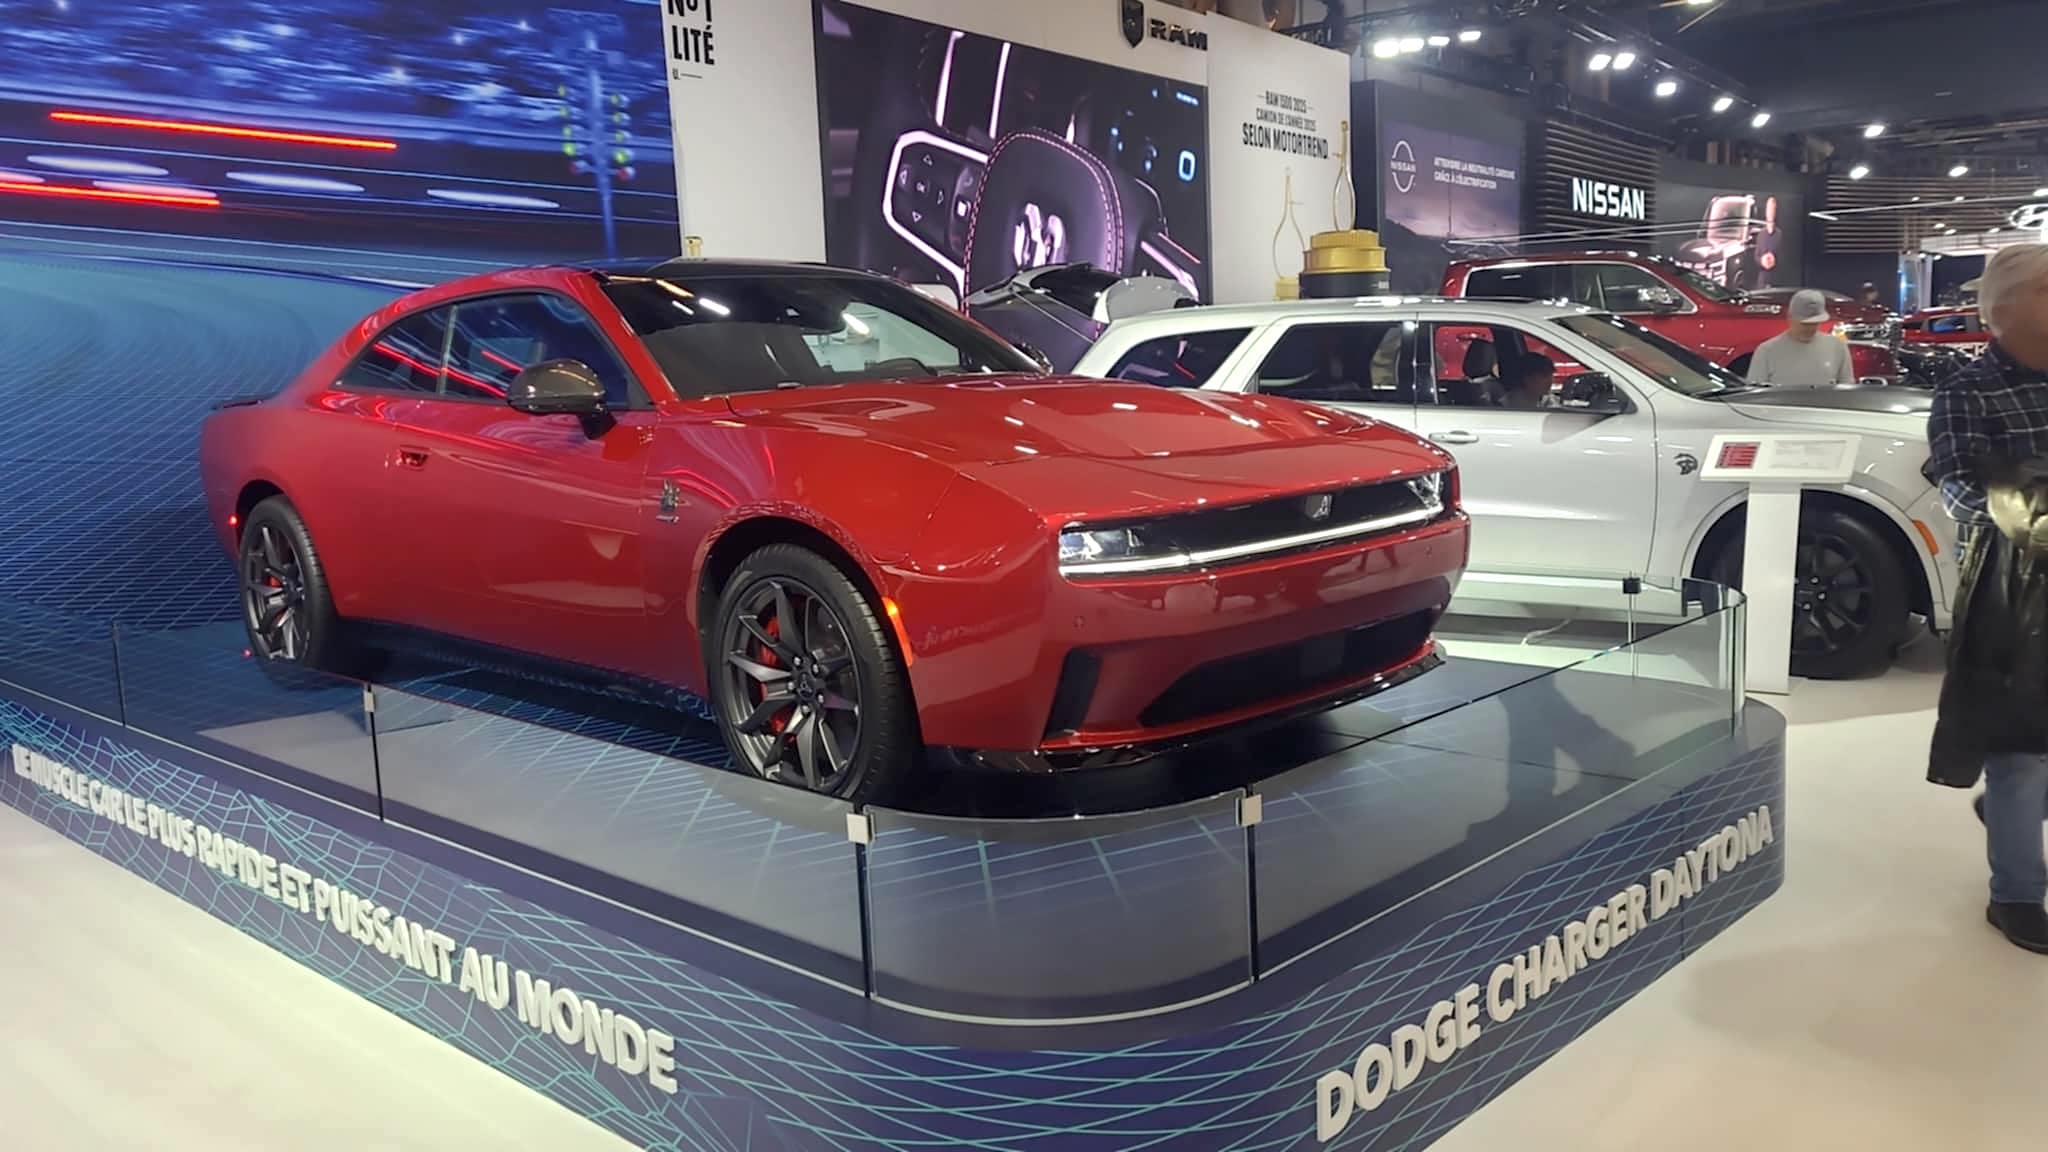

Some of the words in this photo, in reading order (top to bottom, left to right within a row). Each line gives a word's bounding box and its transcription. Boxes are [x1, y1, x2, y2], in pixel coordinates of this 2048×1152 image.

[672, 25, 714, 65] LITÉ
[1150, 18, 1208, 51] RAM
[1242, 121, 1271, 149] SELON
[1273, 128, 1328, 159] MOTORTREND
[1390, 160, 1417, 173] NISSAN
[1572, 177, 1645, 220] NISSAN
[29, 751, 91, 808] MUSCLE
[88, 779, 126, 825] CAR
[123, 793, 149, 836] LE
[146, 803, 198, 858] PLUS
[195, 825, 281, 899] RAPIDE
[279, 863, 313, 914] ET
[313, 878, 456, 984] PUISSANT
[459, 947, 510, 1010] AU
[515, 969, 678, 1094] MONDE
[1316, 983, 1481, 1142] DODGE
[1487, 884, 1648, 1022] CHARGER
[1650, 805, 1774, 921] DAYTONA
